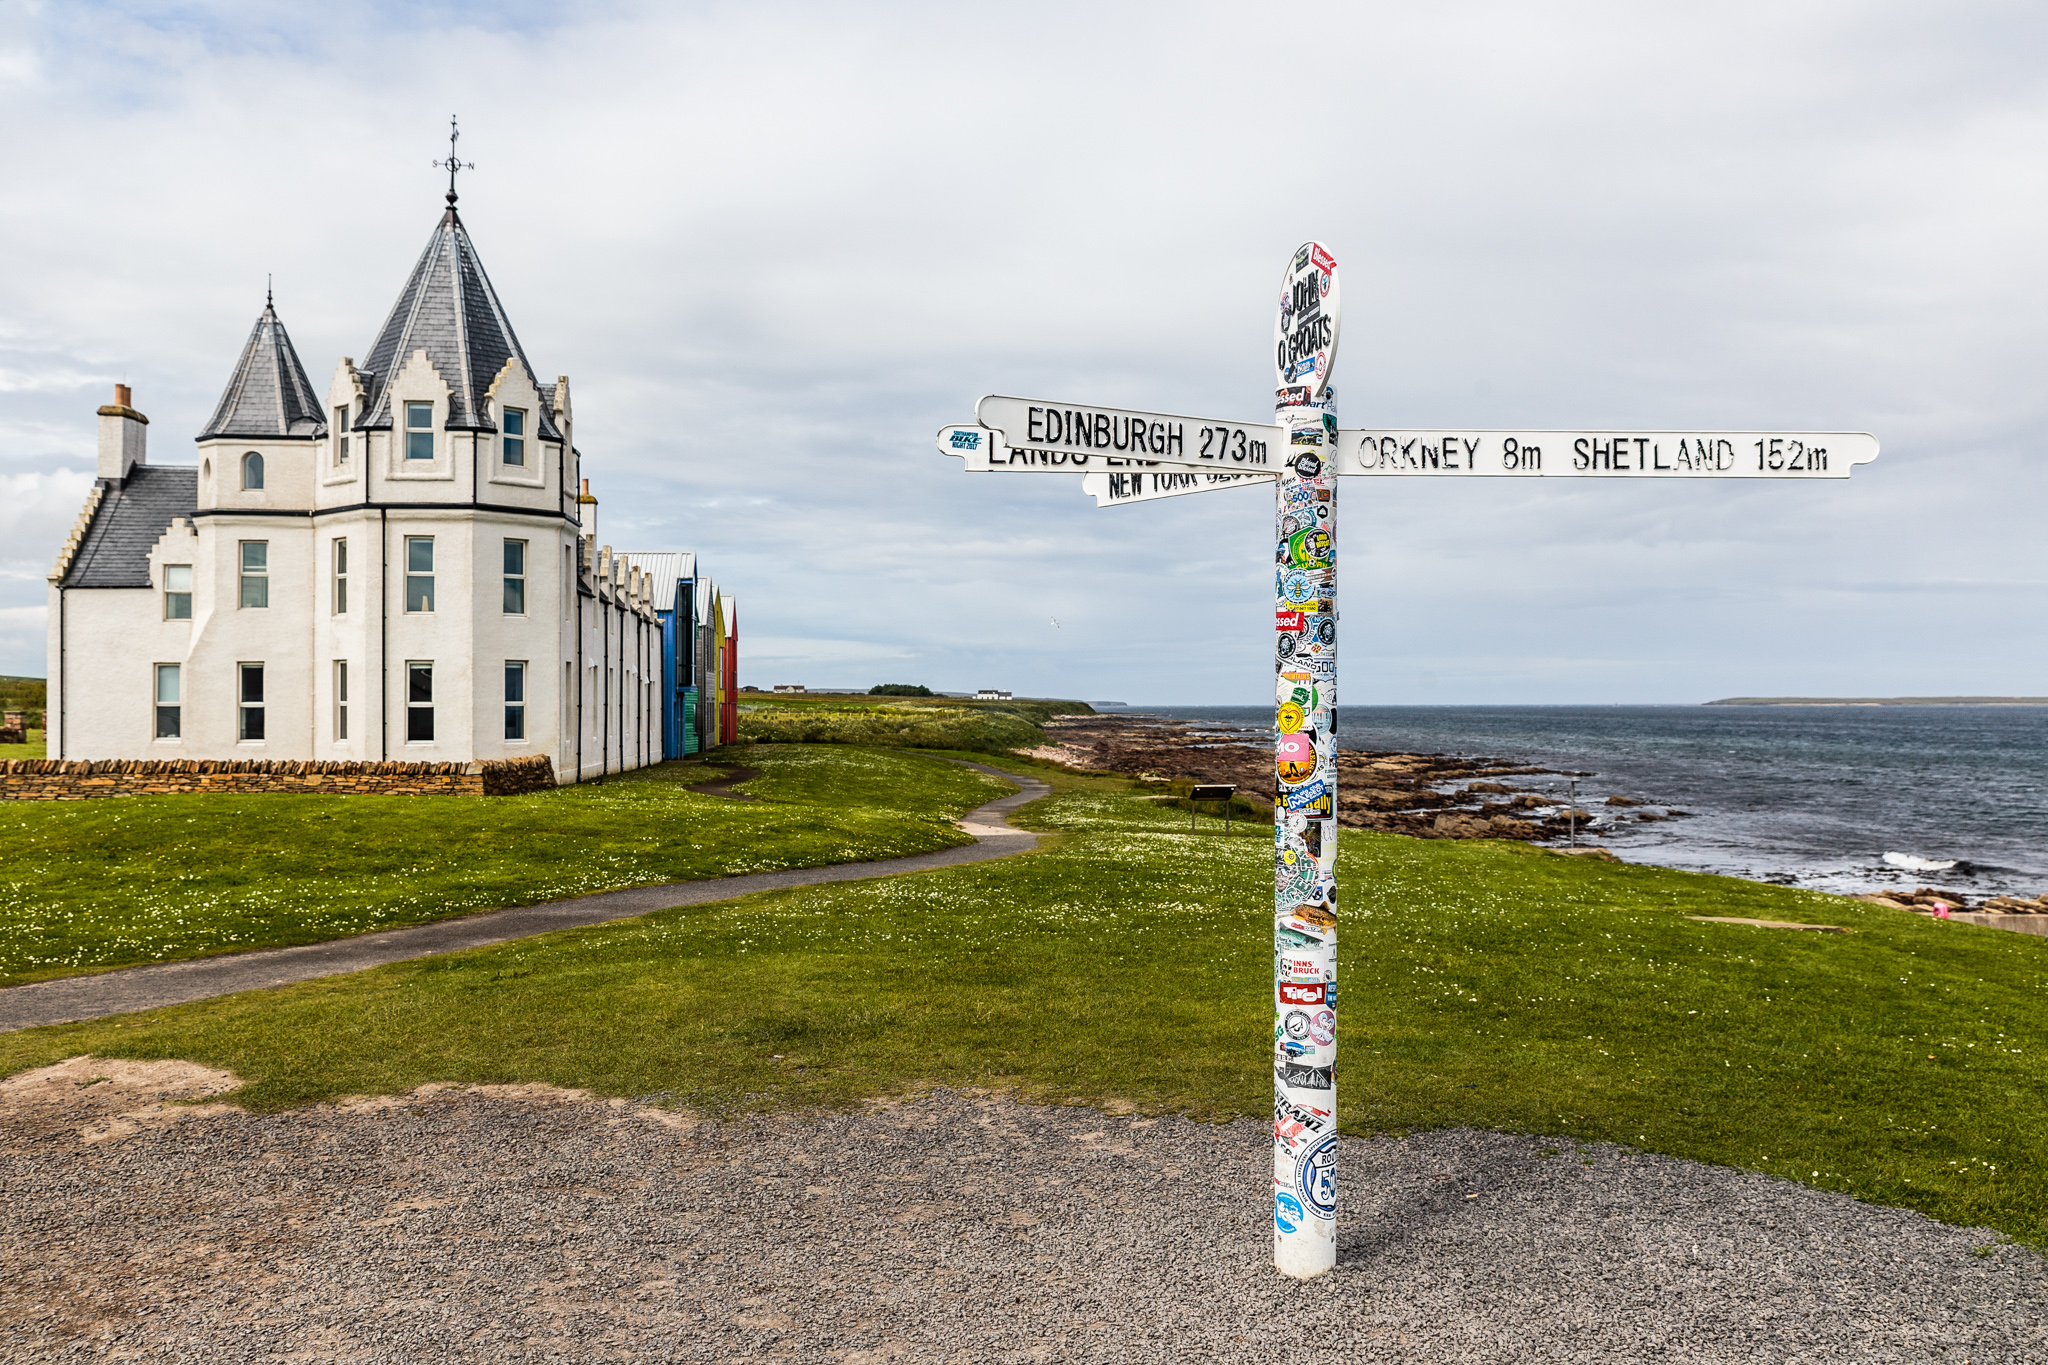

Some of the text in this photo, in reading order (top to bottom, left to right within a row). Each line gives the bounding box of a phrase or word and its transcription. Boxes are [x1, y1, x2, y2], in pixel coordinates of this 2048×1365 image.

[1290, 269, 1320, 316] JOHN
[1027, 407, 1183, 456] EDINBURGH
[1199, 425, 1267, 464] 273m
[1358, 437, 1480, 469] ORKNEY
[1502, 437, 1542, 470] 8m
[1572, 437, 1735, 471] SHETLAND
[1754, 438, 1828, 471] 152m
[1109, 473, 1142, 499] NEW
[1292, 491, 1309, 503] 500
[1293, 967, 1320, 975] BRUCK
[1283, 986, 1323, 1002] Tirol
